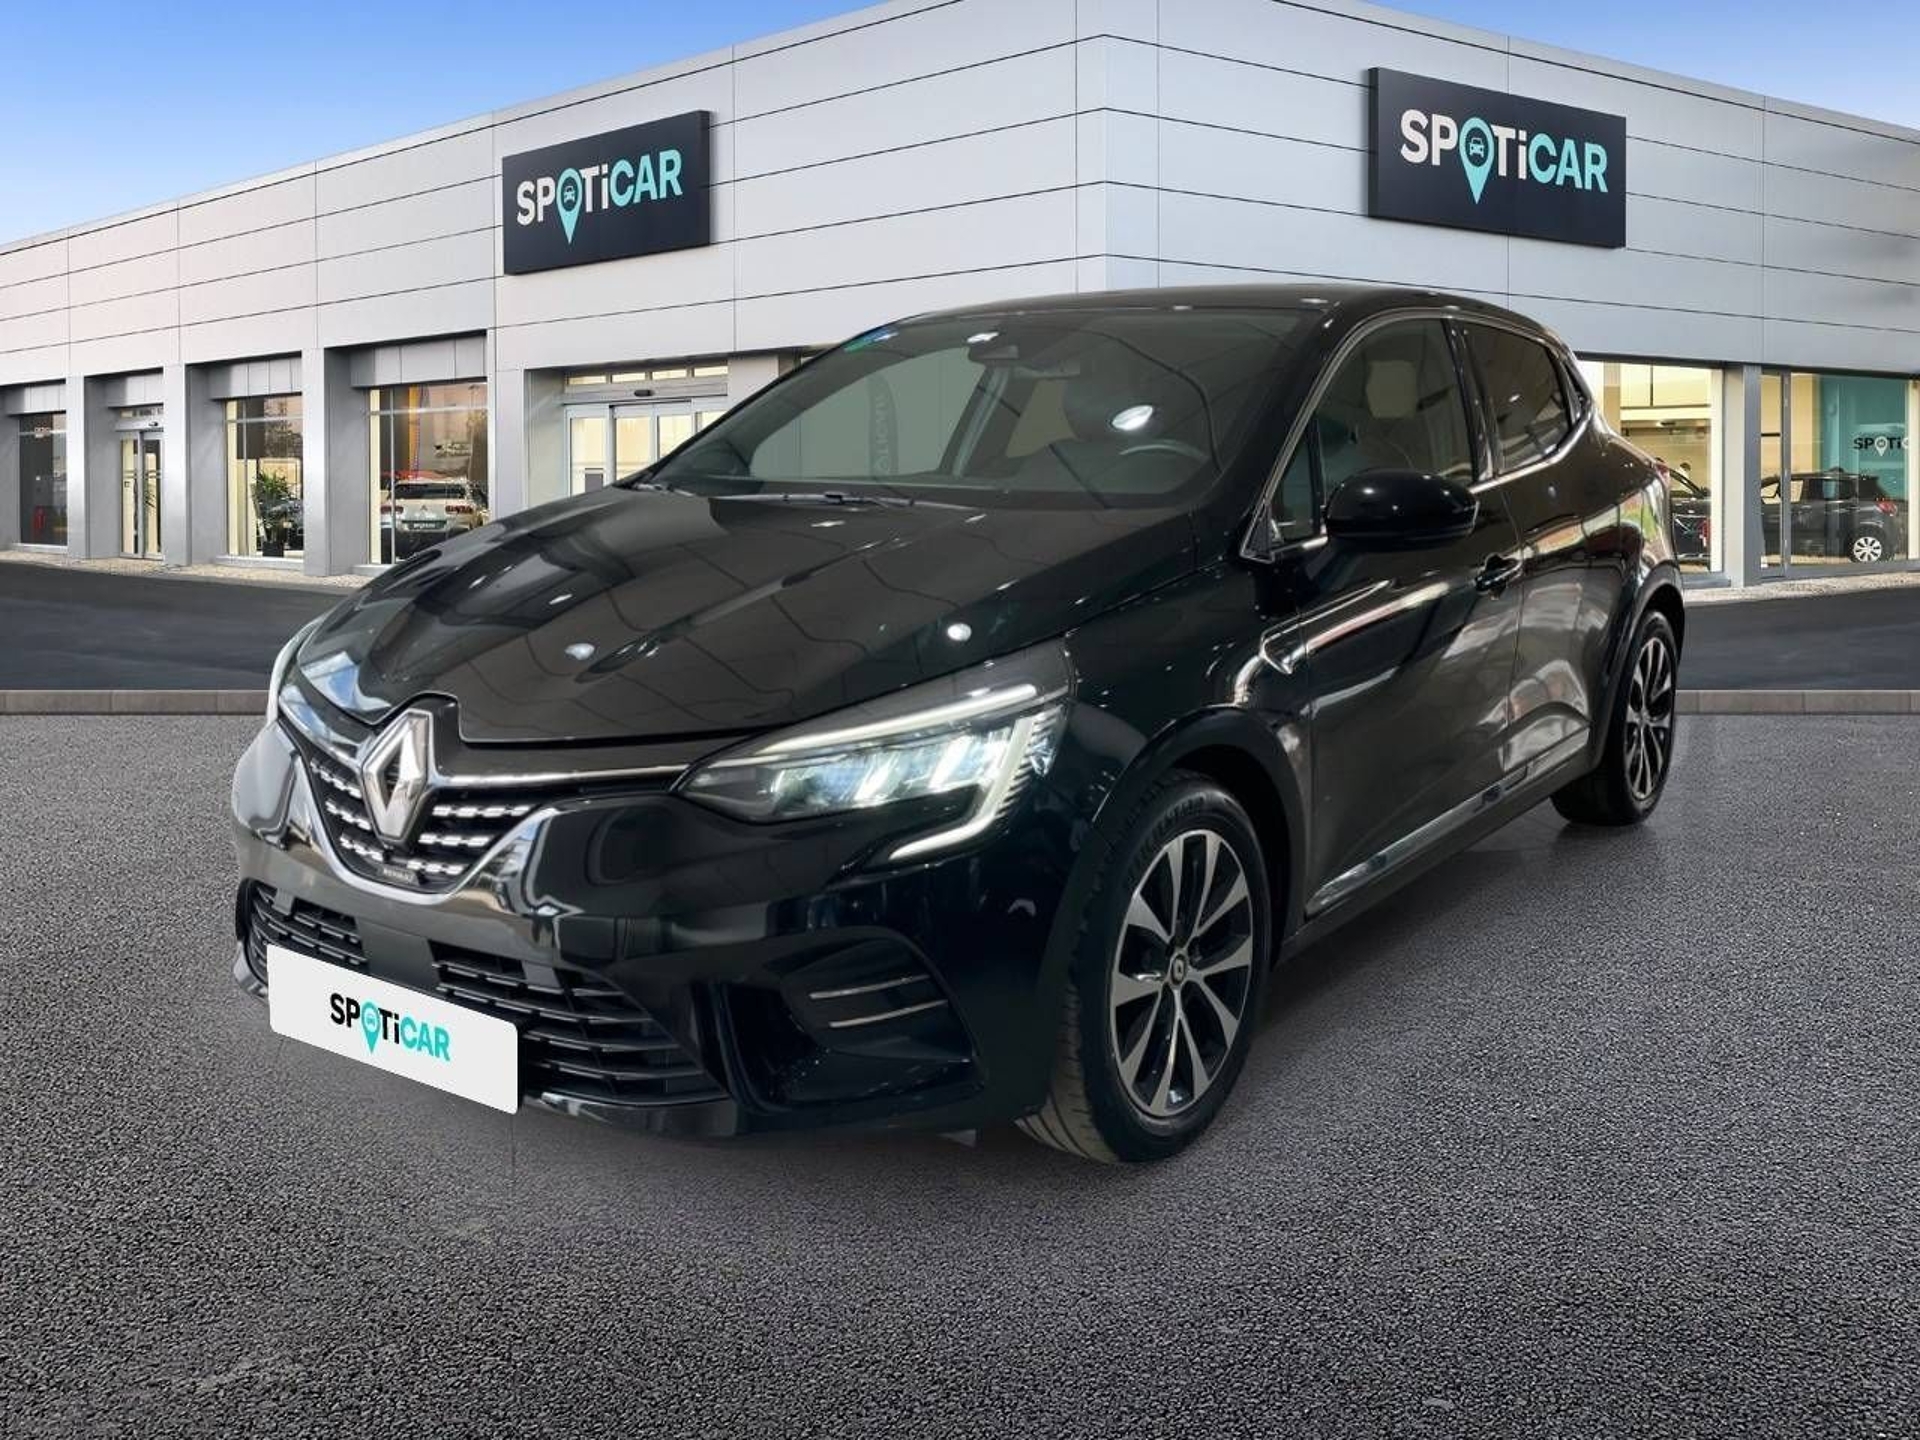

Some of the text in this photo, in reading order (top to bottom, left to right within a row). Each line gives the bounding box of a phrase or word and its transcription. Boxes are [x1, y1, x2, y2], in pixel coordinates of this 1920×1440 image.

[516, 149, 683, 244] SPOTiCAR
[1400, 108, 1609, 204] SPOTiCAR
[330, 993, 451, 1061] SPOTiCAR
